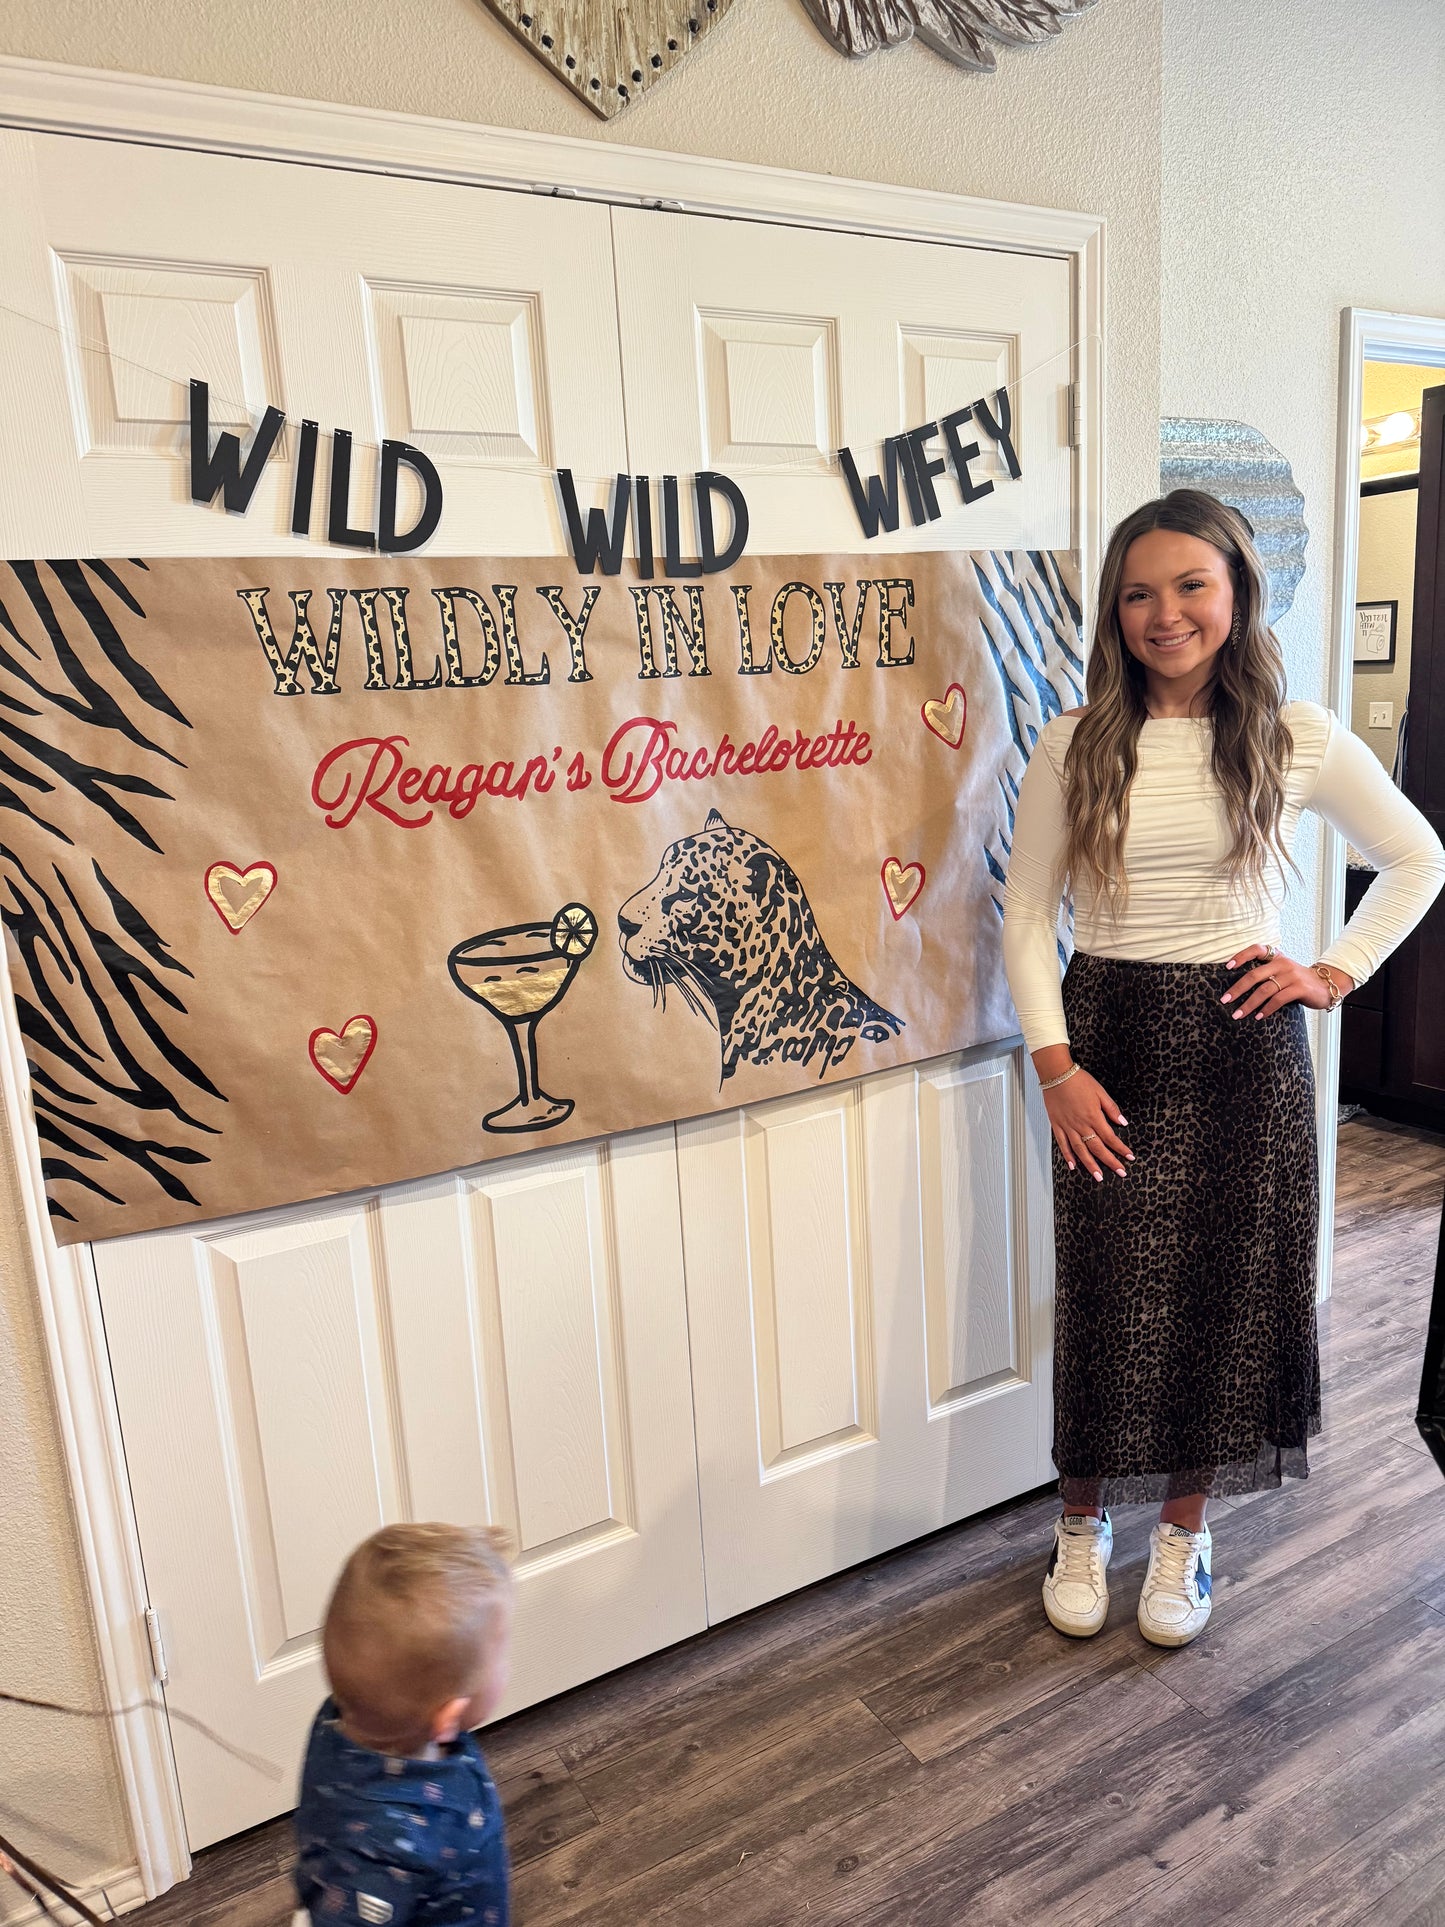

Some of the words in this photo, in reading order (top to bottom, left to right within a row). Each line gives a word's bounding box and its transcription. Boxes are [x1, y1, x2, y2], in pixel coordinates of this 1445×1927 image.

[190, 378, 443, 553] WILD
[558, 468, 749, 579] WILD
[838, 386, 1022, 539] WIFEY
[236, 583, 602, 696] WILDLY
[628, 584, 712, 680] IN
[729, 578, 916, 675] LOVE
[311, 735, 592, 829] Reagan's
[601, 717, 873, 804] Bachelorette
